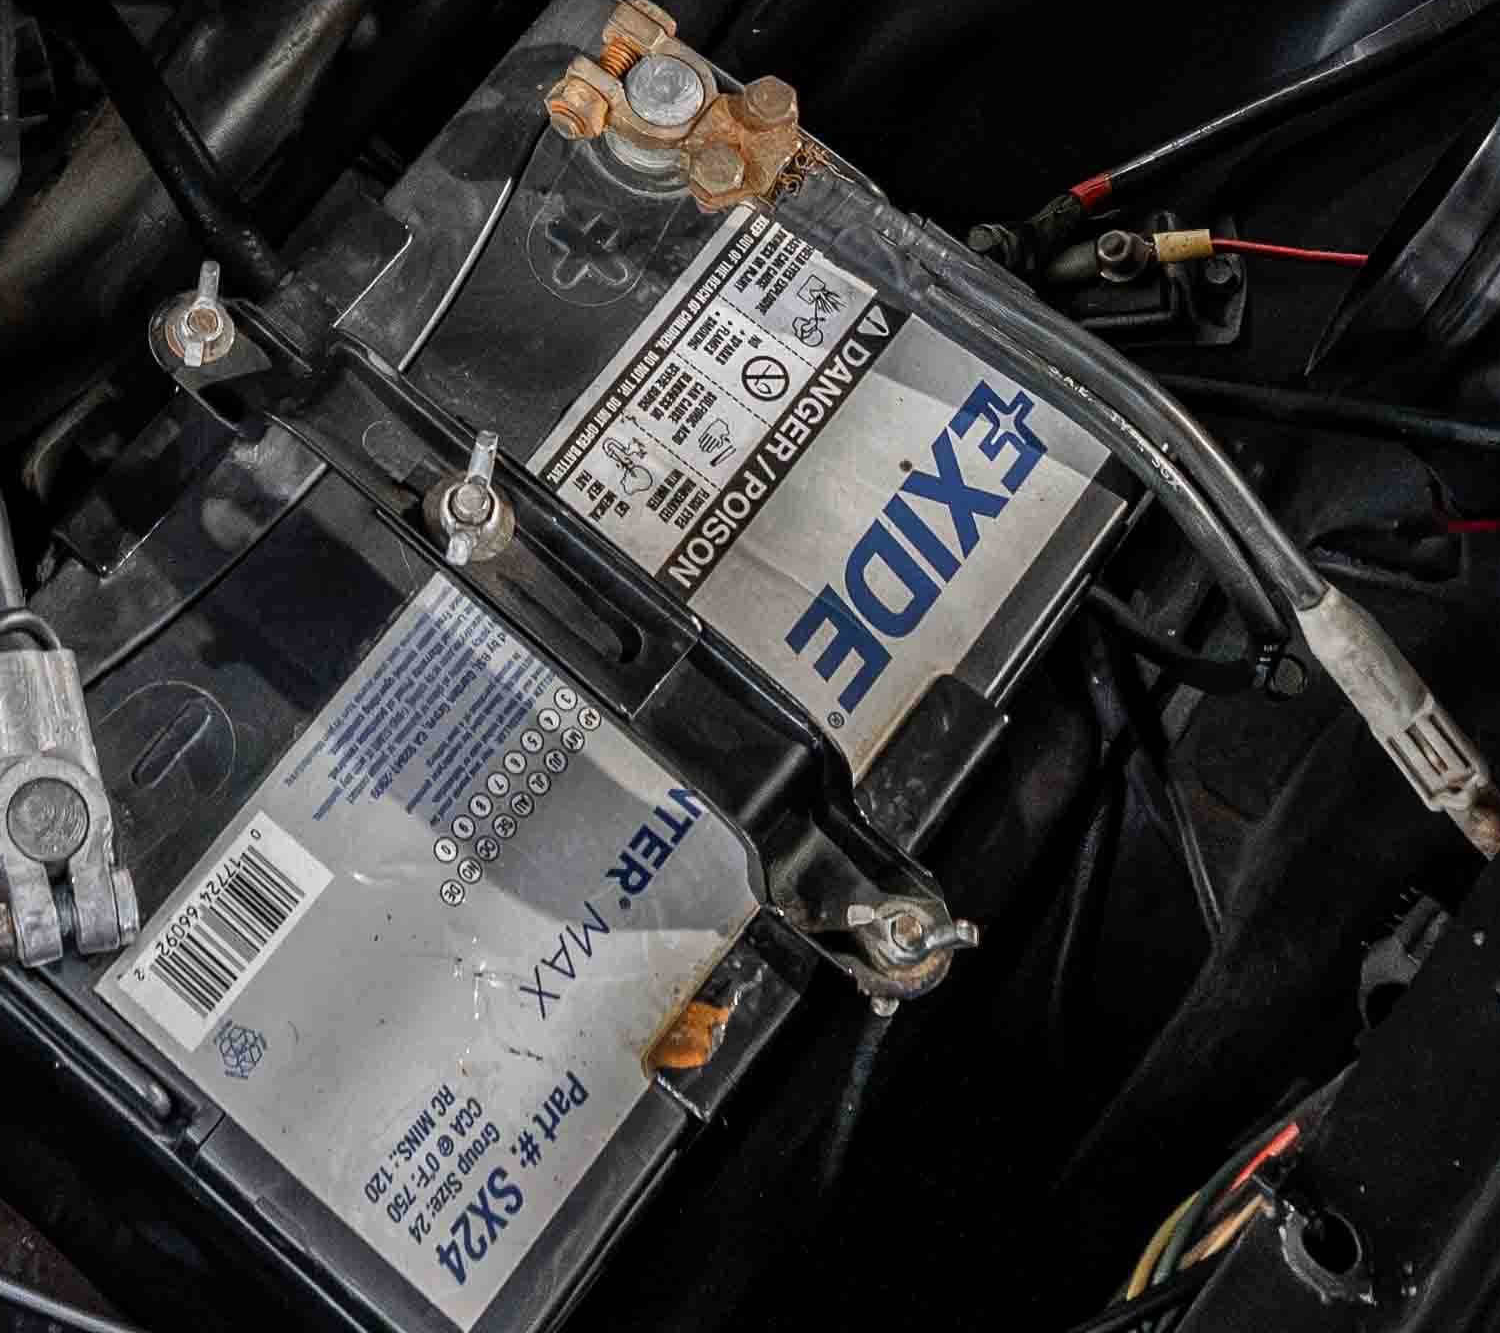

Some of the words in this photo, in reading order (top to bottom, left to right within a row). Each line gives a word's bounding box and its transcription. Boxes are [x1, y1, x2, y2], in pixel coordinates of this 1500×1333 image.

[747, 213, 770, 238] KEEP
[725, 247, 742, 264] OF
[734, 232, 755, 253] OUT
[713, 258, 733, 280] THE
[693, 273, 721, 304] REACH
[685, 298, 702, 314] OF
[627, 361, 650, 384] NOT
[641, 348, 660, 367] DO
[604, 395, 622, 413] DO
[761, 336, 873, 465] DANGER
[591, 407, 612, 428] NOT
[573, 421, 600, 450] OPEN
[664, 471, 767, 590] POISON
[781, 378, 1052, 715] EXIDE
[247, 826, 263, 842] 0
[603, 788, 705, 899] NTER
[195, 853, 244, 906] 17724
[152, 904, 203, 959] 66092
[130, 967, 147, 983] 2
[517, 901, 611, 1021] MAX
[427, 1084, 456, 1115] RC
[529, 1069, 591, 1141] Part
[447, 1095, 484, 1136] CCA
[430, 1131, 458, 1160] @
[452, 1119, 503, 1176] Group
[507, 1131, 543, 1170] #:
[360, 1164, 394, 1204] 120
[422, 1170, 466, 1219] Size:
[382, 1183, 416, 1224] 750
[405, 1213, 432, 1244] 24
[428, 1163, 528, 1288] SX24
